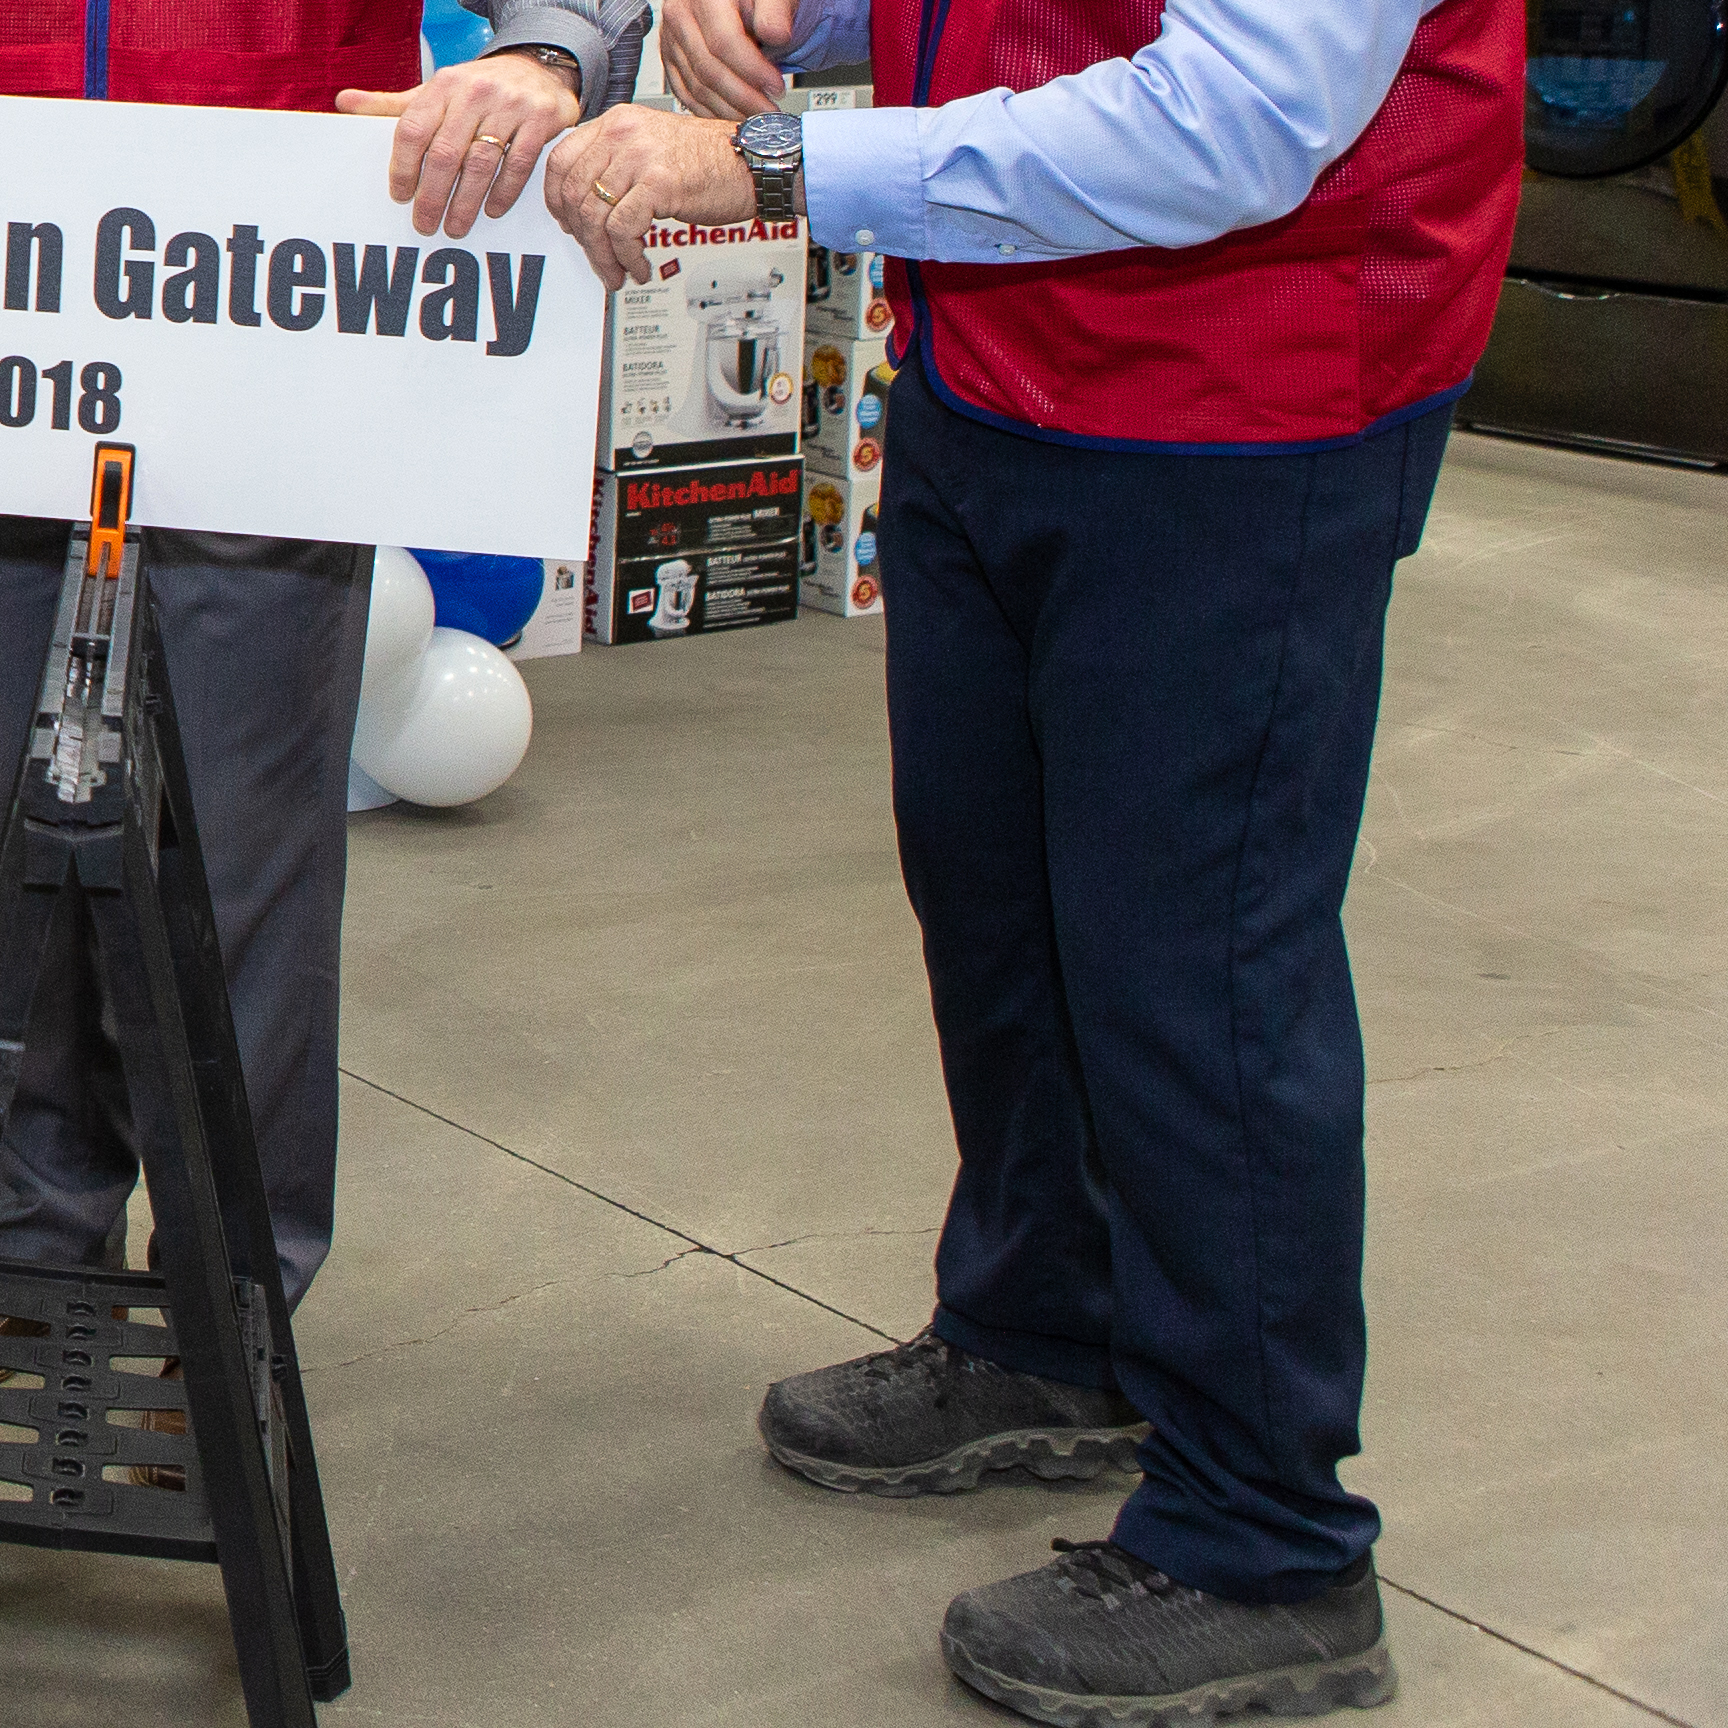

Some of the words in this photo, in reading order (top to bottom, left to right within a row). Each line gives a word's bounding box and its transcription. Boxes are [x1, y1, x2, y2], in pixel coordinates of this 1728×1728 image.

[94, 206, 546, 358] Gateway
[624, 295, 652, 304] MIXER
[624, 325, 660, 335] BATTEUR
[623, 361, 663, 372] BATIDORA
[627, 470, 799, 510] KitchenAid
[753, 507, 780, 518] MIXER
[707, 554, 741, 566] BATTEUR
[705, 588, 745, 600] BATIDORA
